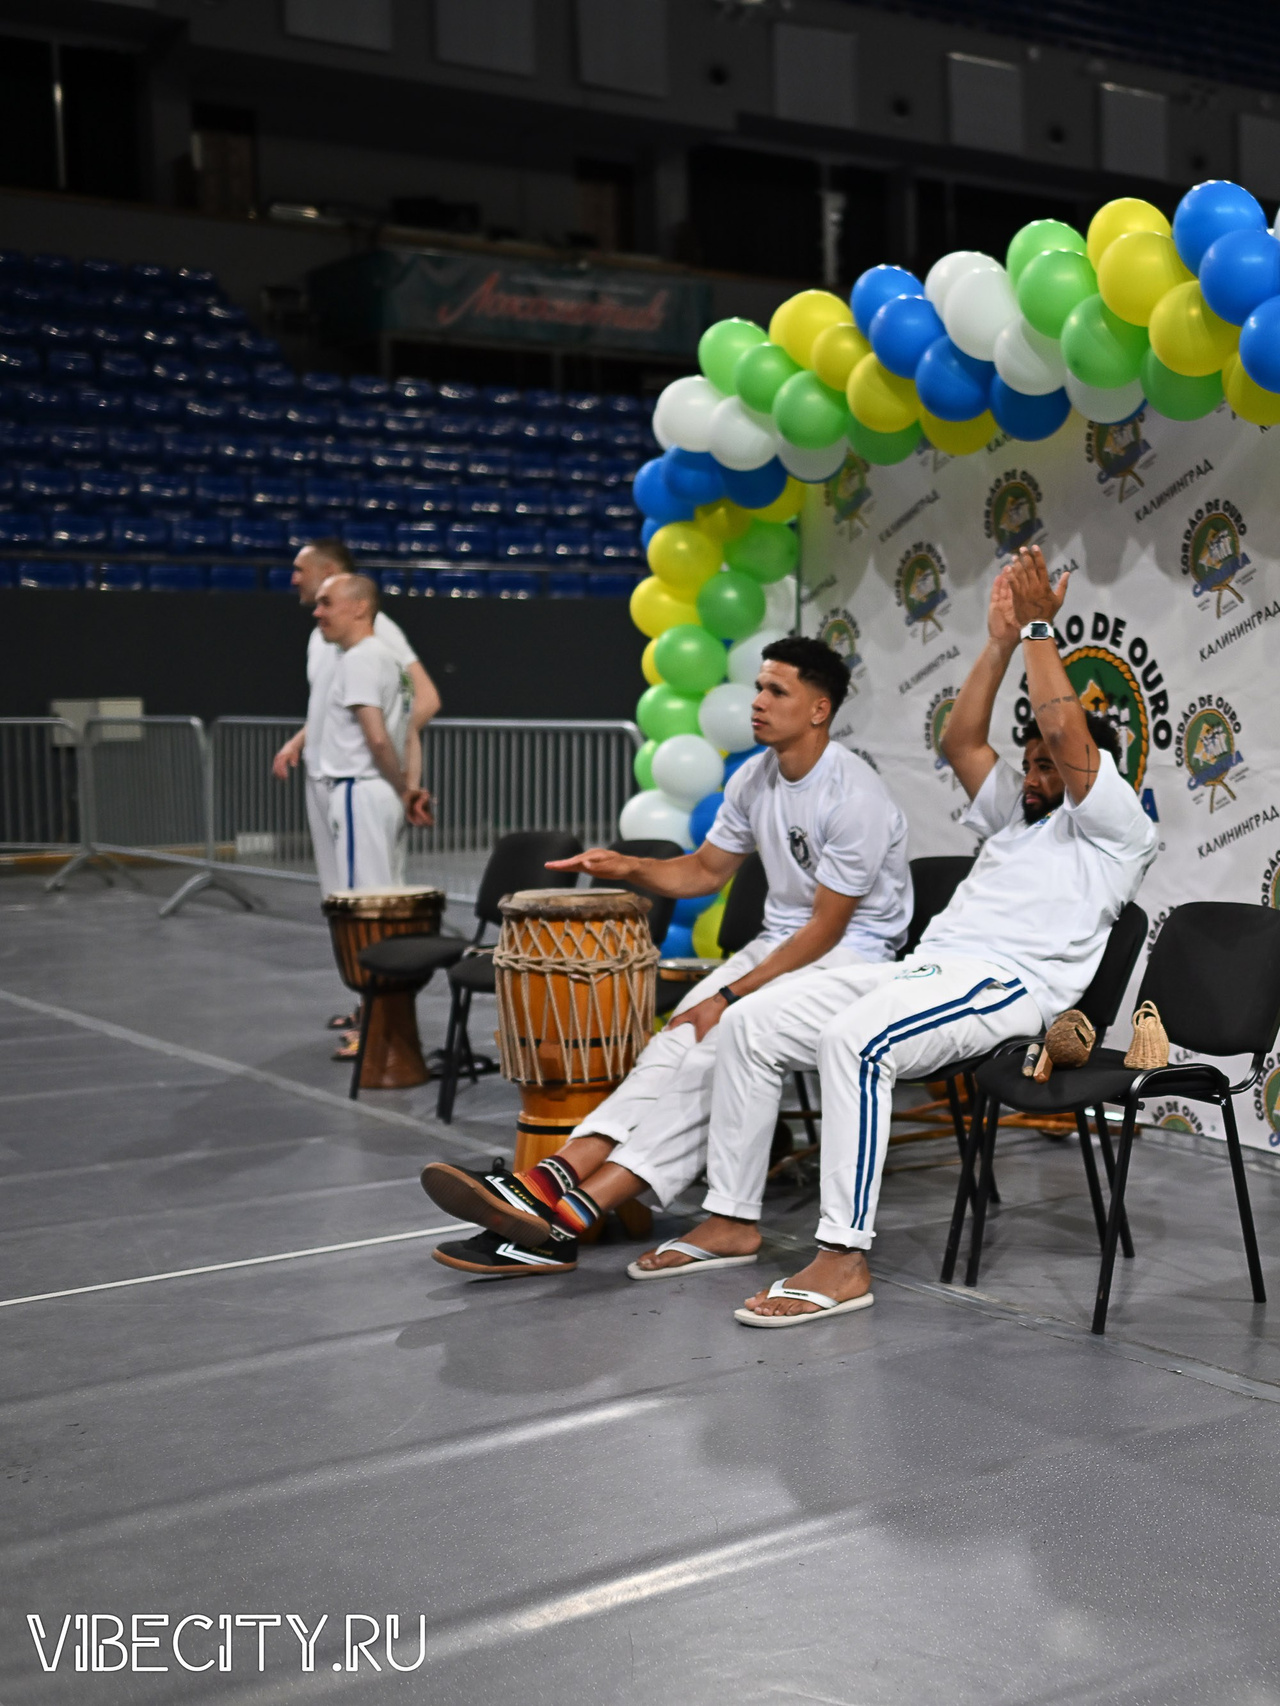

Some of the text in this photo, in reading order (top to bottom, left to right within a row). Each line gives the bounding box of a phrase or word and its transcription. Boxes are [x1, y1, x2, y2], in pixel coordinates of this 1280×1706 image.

[1134, 458, 1214, 523] КАЛИНИНГРАД
[1205, 499, 1220, 513] DE
[1222, 500, 1247, 536] OURO
[1091, 611, 1126, 648] DE
[1128, 637, 1173, 750] OURO
[1198, 694, 1213, 708] DE
[1215, 697, 1242, 734] OURO
[1197, 805, 1280, 859] КАЛИНИНГРАД
[1182, 1105, 1204, 1135] OUR
